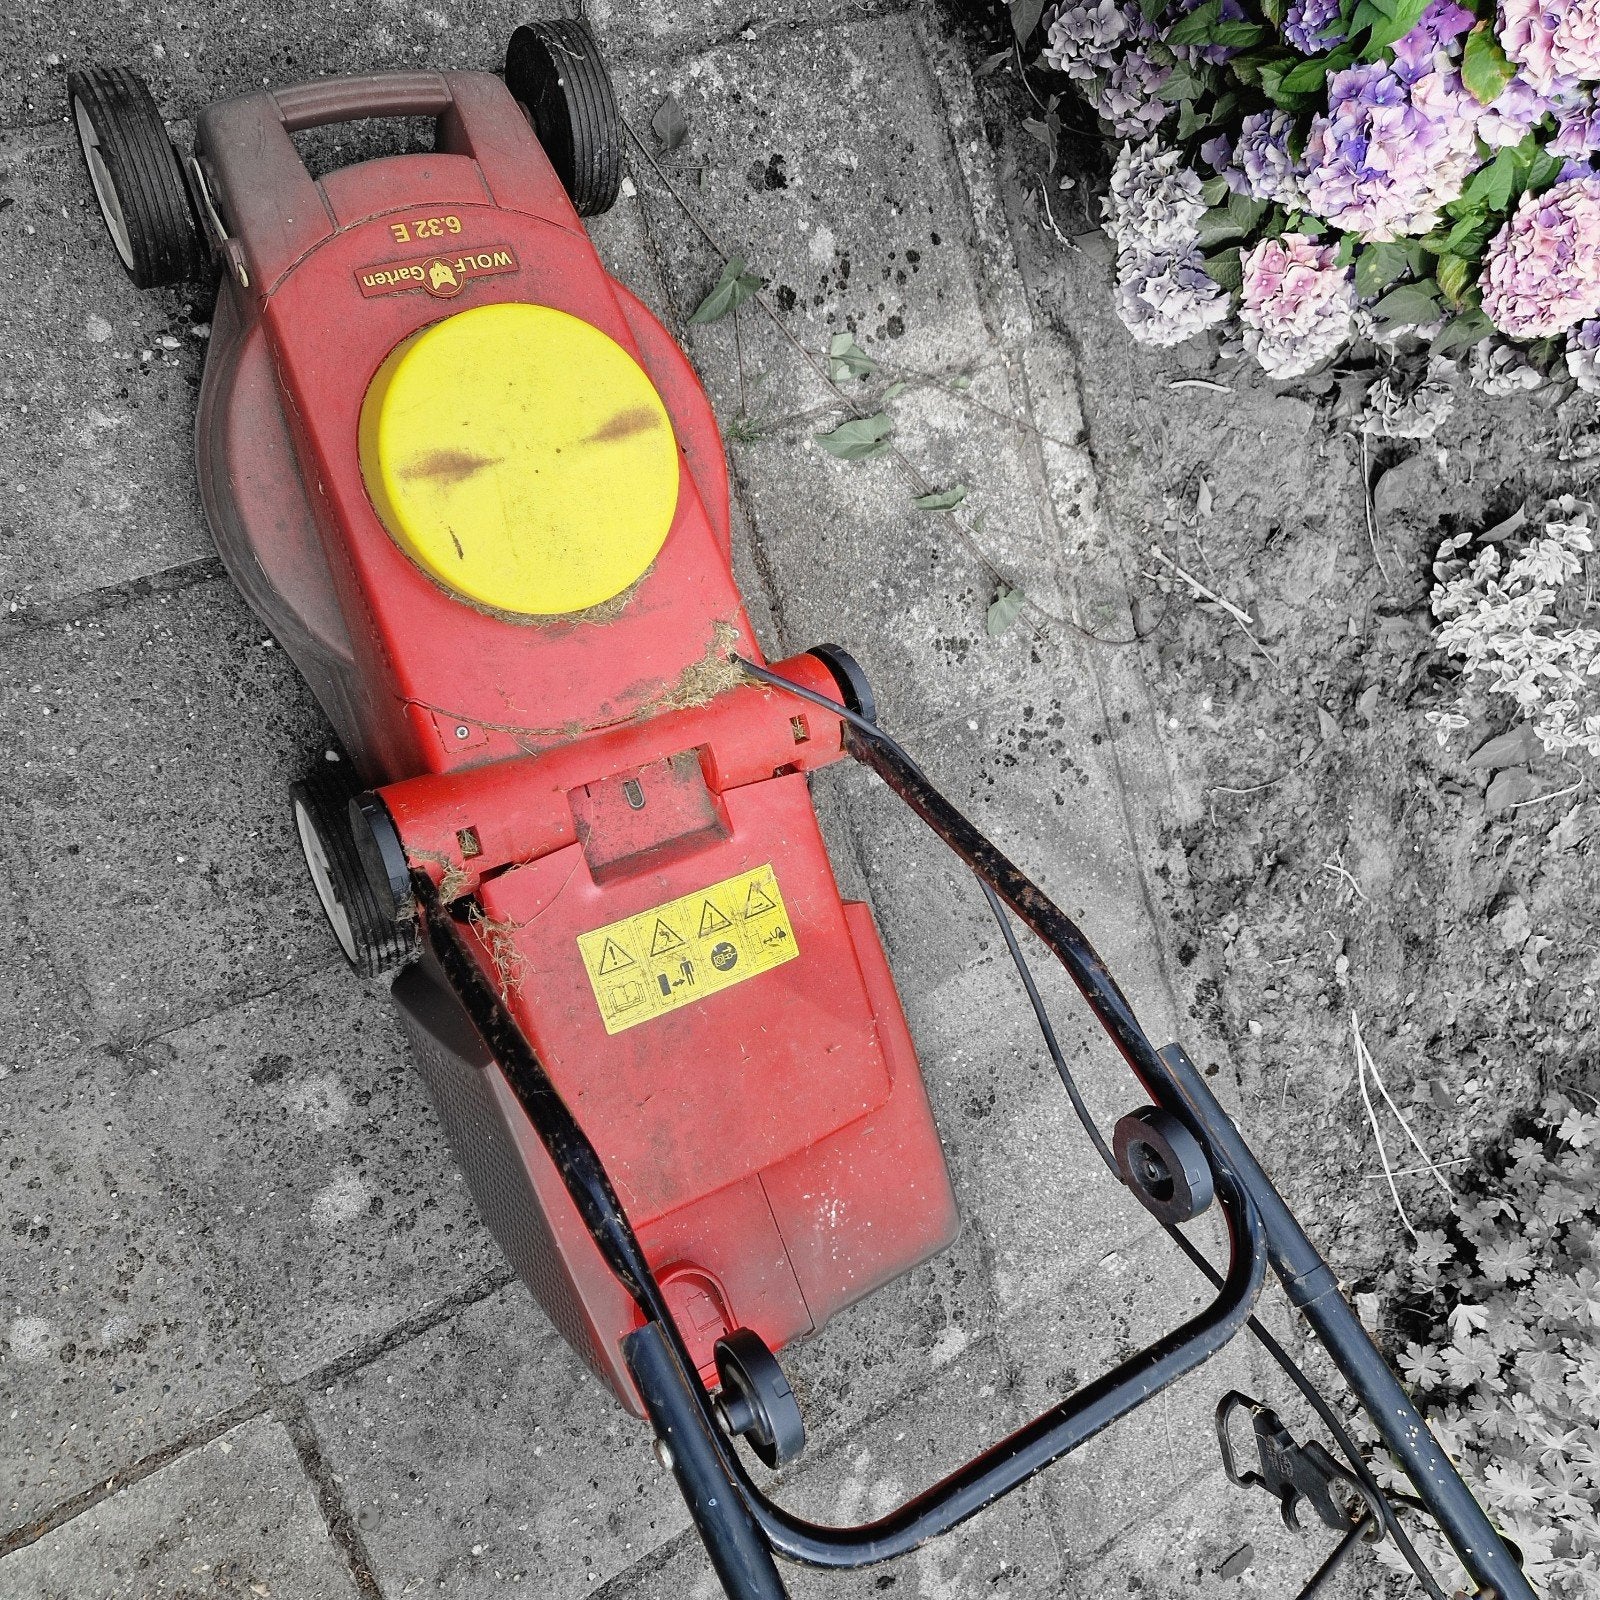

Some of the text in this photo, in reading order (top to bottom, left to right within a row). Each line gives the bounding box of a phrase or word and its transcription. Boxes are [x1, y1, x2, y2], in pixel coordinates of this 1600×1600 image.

[390, 215, 462, 243] 6.32 E
[363, 251, 513, 287] WOLF Garten
